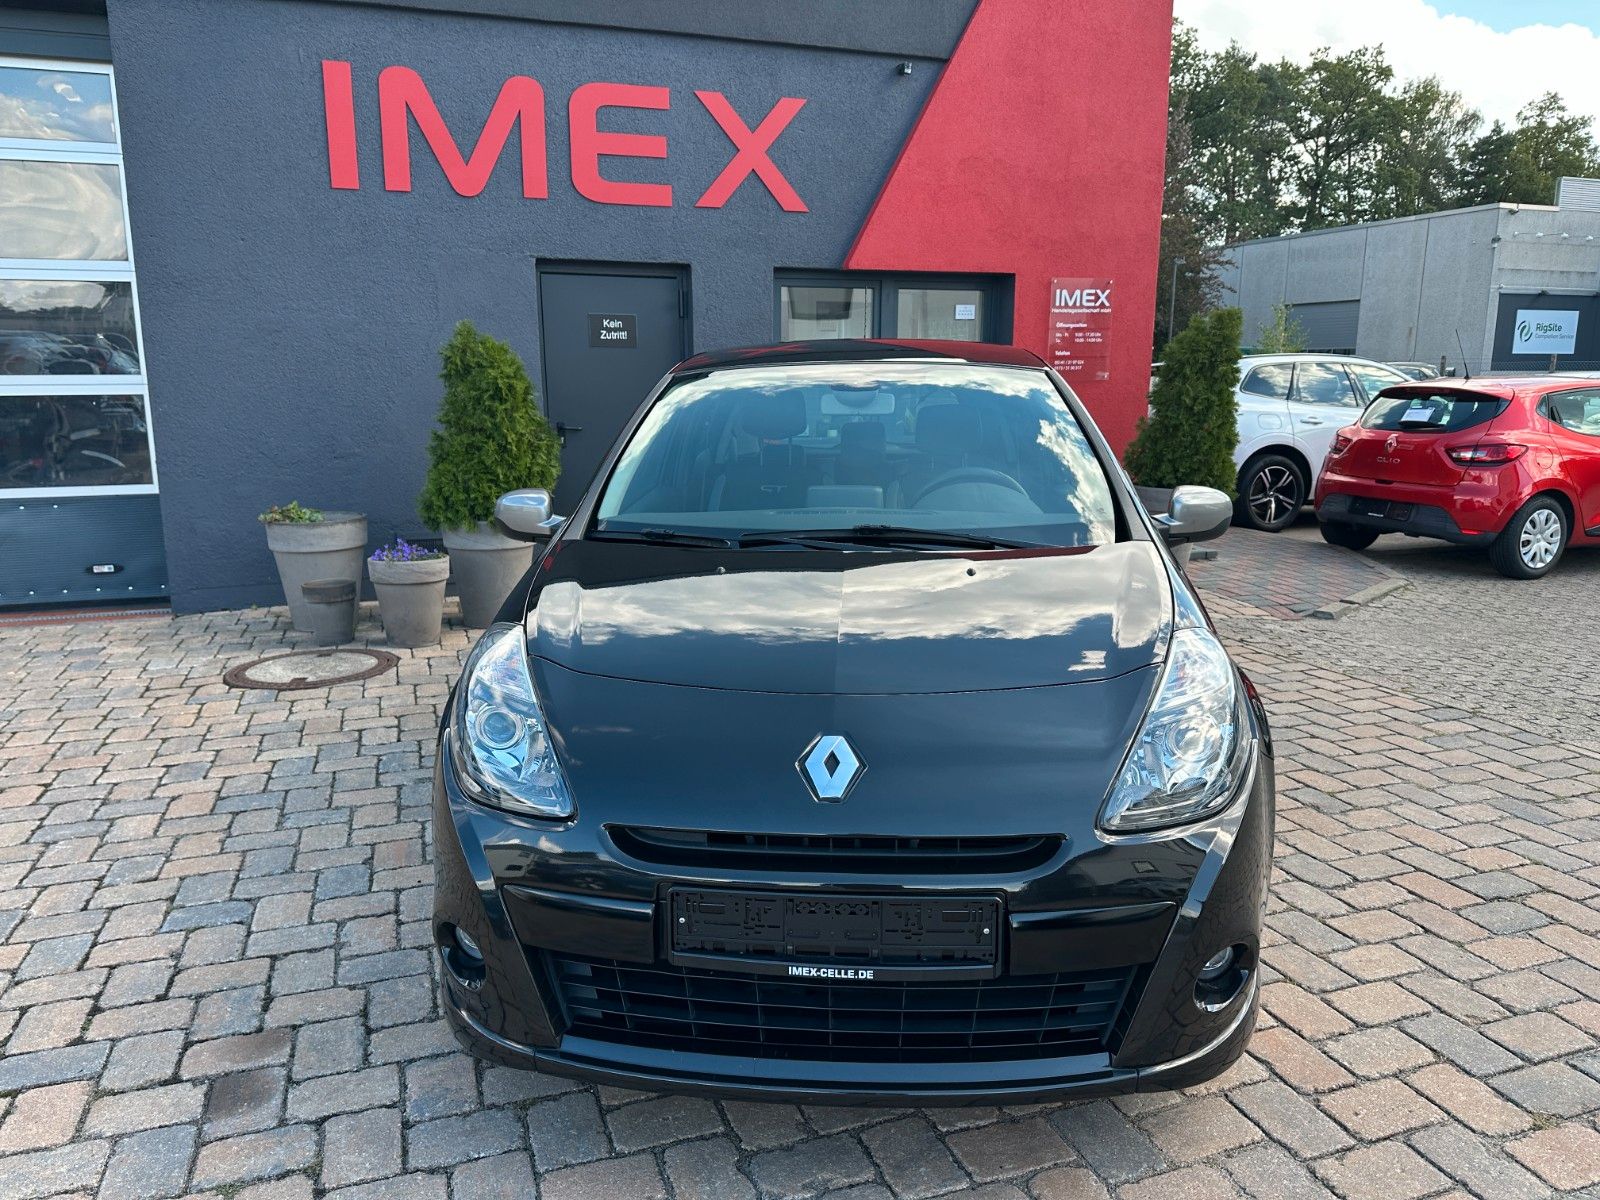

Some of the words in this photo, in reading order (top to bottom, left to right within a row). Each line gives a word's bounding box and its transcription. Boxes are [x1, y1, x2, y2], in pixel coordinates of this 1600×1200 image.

[322, 60, 809, 212] IMEX
[1055, 289, 1110, 306] IMEX
[603, 319, 623, 328] Kein
[1536, 323, 1562, 334] RigSite
[600, 330, 627, 340] Zutritt!
[1376, 456, 1400, 464] CLIO
[788, 966, 874, 979] IMEX-CELLE.DE
